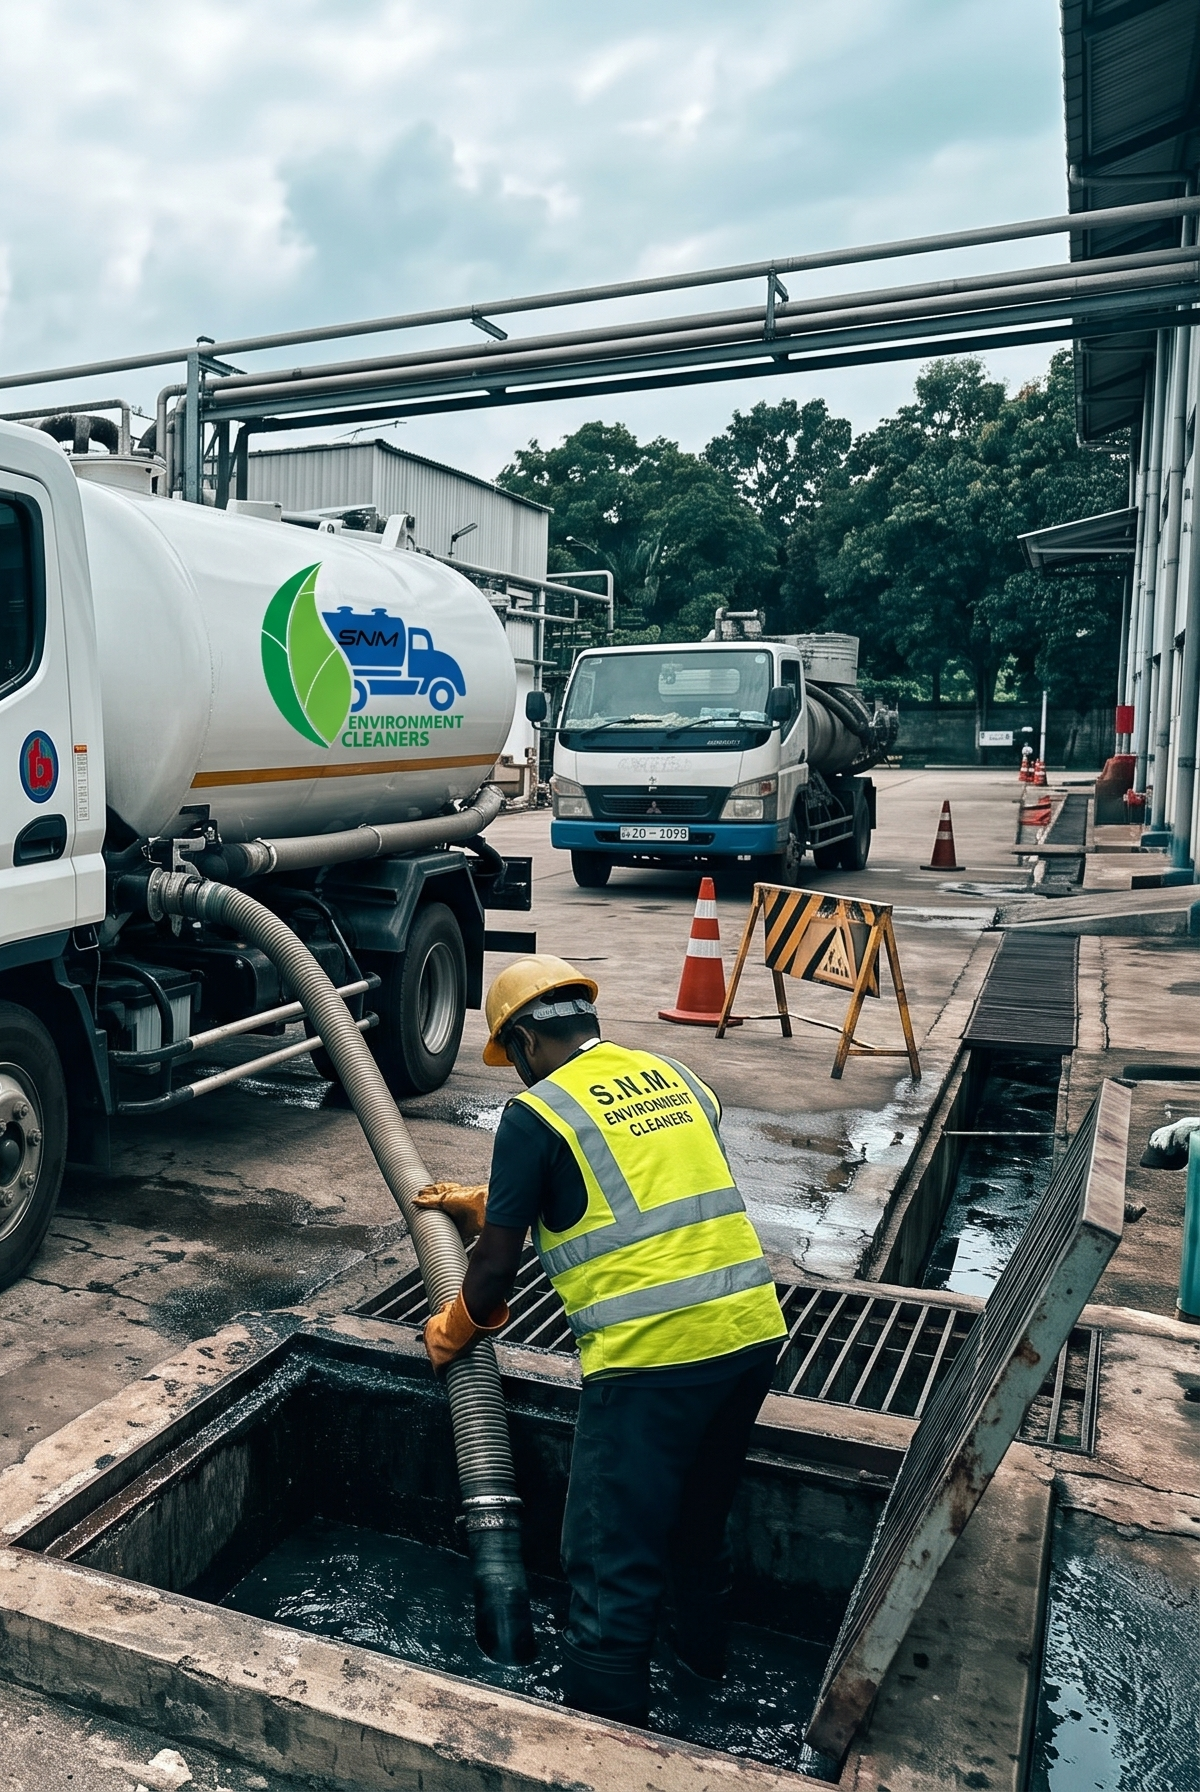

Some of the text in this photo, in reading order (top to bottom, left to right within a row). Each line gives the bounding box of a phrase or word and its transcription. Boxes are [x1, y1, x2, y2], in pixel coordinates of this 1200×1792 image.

[338, 630, 399, 647] SNM
[348, 715, 464, 729] ENVIRONMENT
[341, 731, 430, 748] CLEANERS
[589, 1069, 679, 1106] S.N.M.
[629, 1110, 694, 1137] CLEANERS
